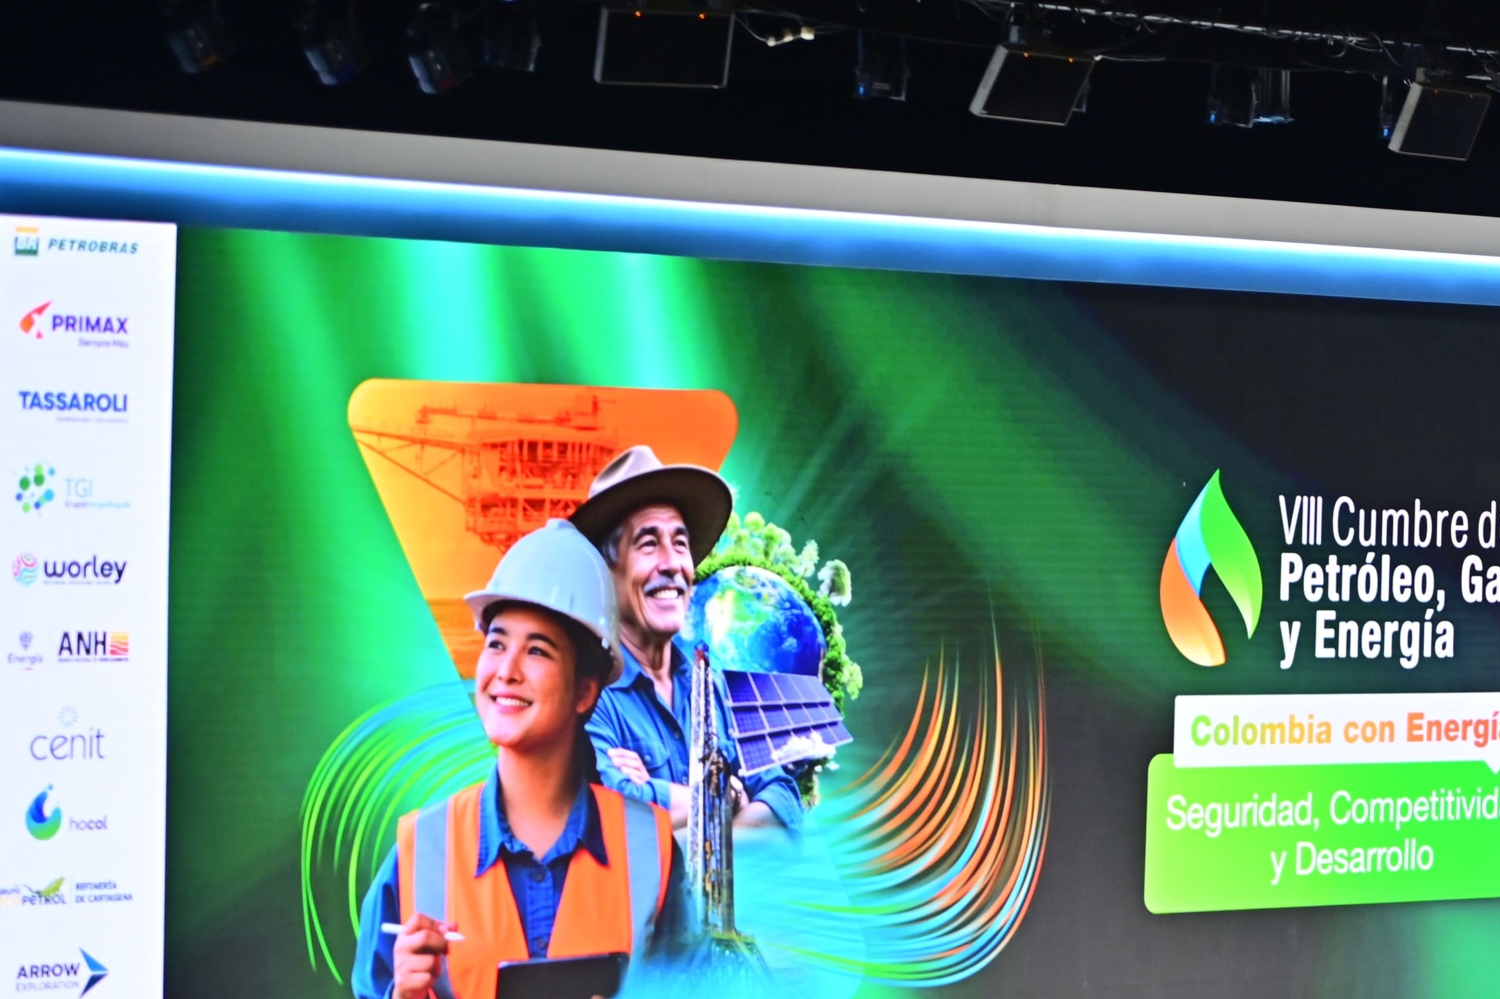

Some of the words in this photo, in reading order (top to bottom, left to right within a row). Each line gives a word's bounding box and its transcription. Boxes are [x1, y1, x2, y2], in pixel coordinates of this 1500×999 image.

[48, 238, 138, 254] PETROBRAS
[52, 314, 128, 335] PRIMAX
[19, 391, 128, 413] TASSAROLI
[1278, 494, 1323, 546] VIII
[1332, 495, 1469, 548] Cumbre
[43, 556, 127, 584] worley
[1279, 551, 1445, 611] Petróleo,
[58, 631, 107, 656] ANH
[1279, 620, 1301, 669] y
[1315, 608, 1455, 669] Energía
[30, 727, 105, 760] cenit
[1190, 713, 1332, 746] Colombia
[1343, 719, 1395, 744] con
[69, 816, 108, 830] hocol
[1165, 791, 1320, 838] Seguridad,
[1270, 851, 1287, 885] y
[1295, 838, 1434, 876] Desarrollo
[17, 963, 80, 979] ARROW
